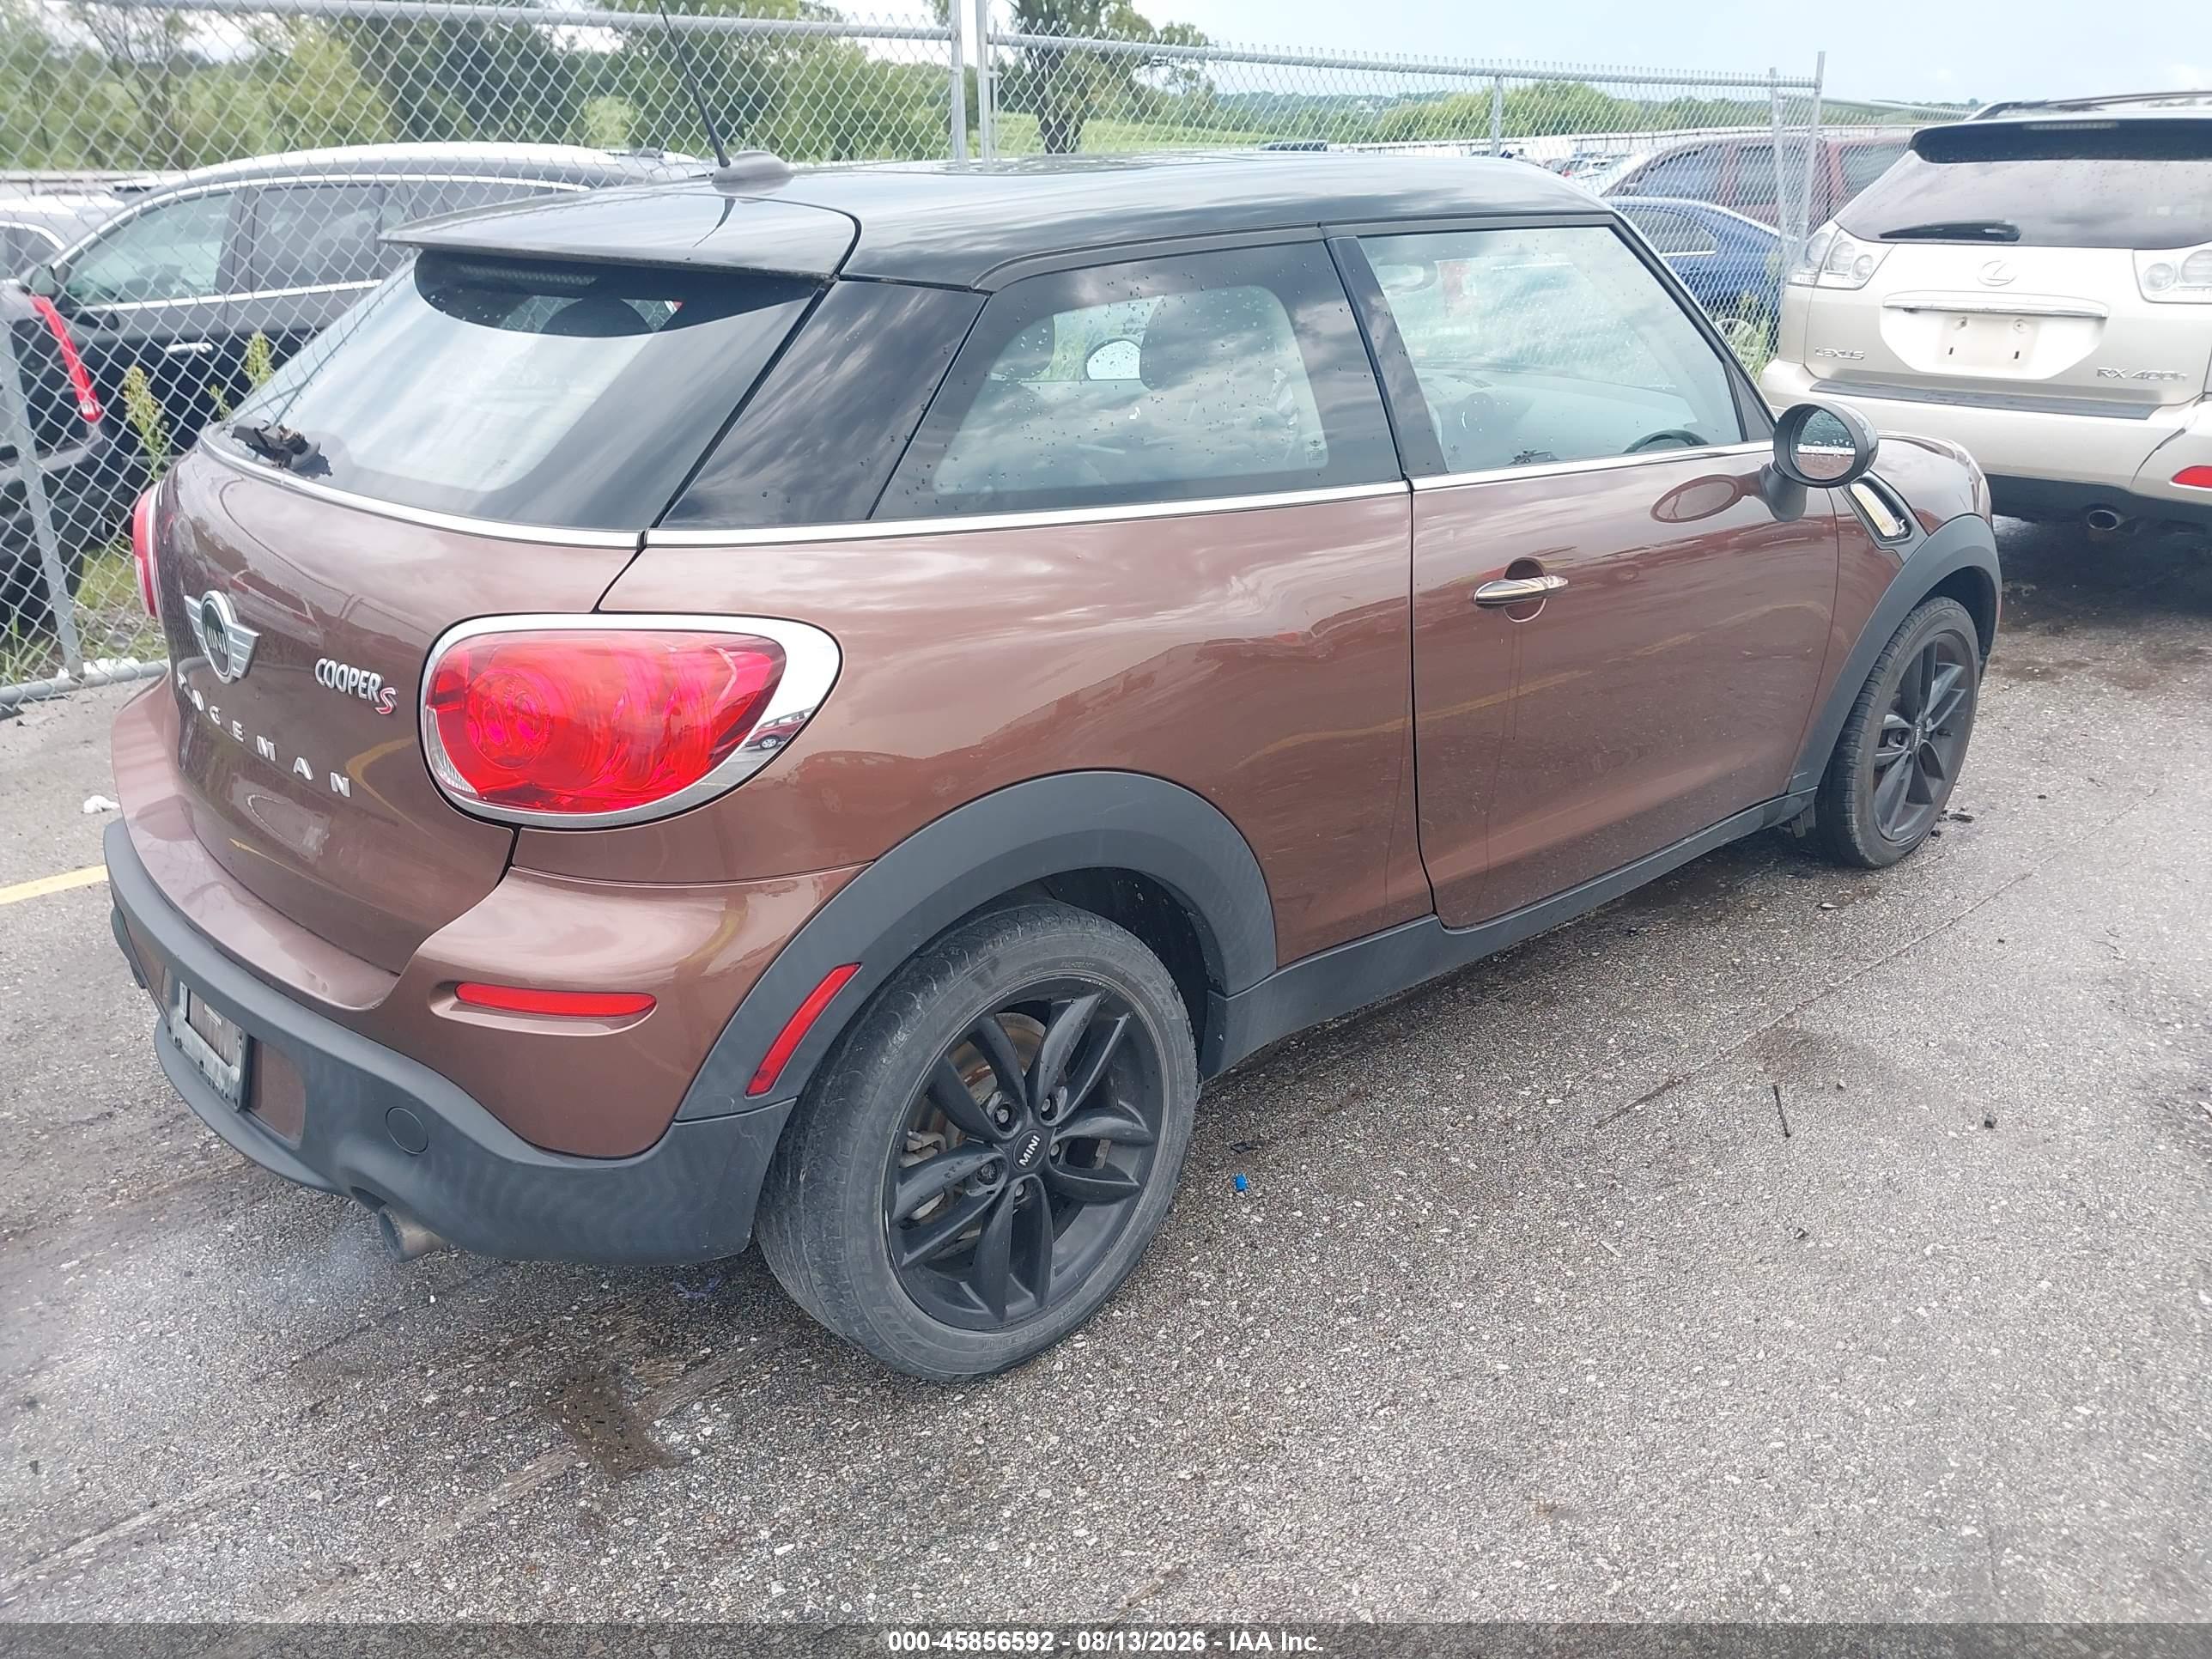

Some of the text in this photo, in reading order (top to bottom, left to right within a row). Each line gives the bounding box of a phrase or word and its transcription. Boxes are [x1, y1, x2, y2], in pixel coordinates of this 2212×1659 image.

[1814, 346, 1864, 360] LEXUS
[2097, 367, 2129, 379] RX
[314, 657, 383, 703] COOPER
[1018, 1134, 1041, 1166] MINI
